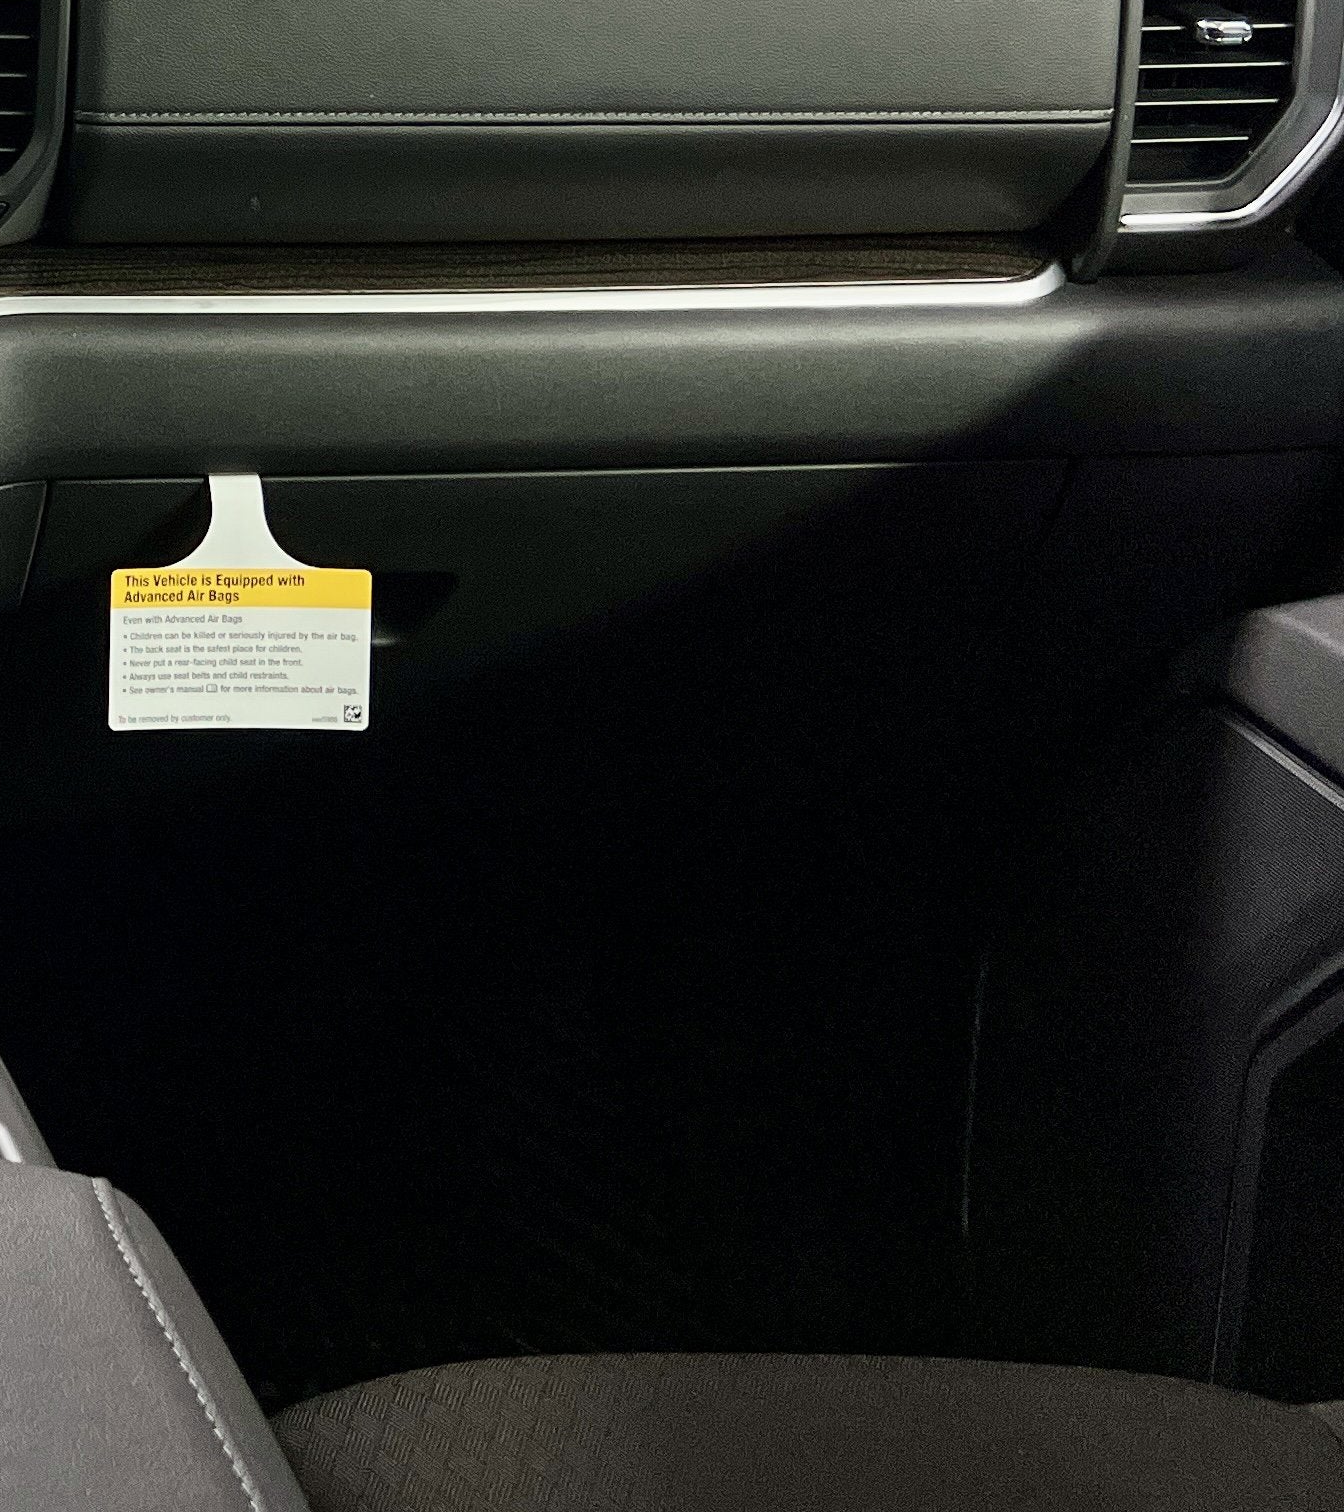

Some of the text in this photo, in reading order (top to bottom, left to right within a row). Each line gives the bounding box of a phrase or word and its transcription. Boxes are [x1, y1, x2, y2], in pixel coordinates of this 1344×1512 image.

[125, 574, 305, 588] This Vehicle is Equipped with
[124, 590, 240, 604] Advanced Air Bags
[123, 615, 243, 624] Even with Advanced Air Bags
[130, 632, 163, 640] Children
[229, 631, 265, 640] seriously
[268, 631, 296, 640] injured
[299, 632, 308, 640] by
[312, 632, 324, 640] the
[207, 645, 230, 653] safest
[232, 645, 253, 654] place
[130, 659, 151, 667] Never
[153, 660, 166, 668] put
[175, 658, 216, 667] rear-facing
[219, 658, 237, 666] child
[129, 673, 155, 681] Always
[129, 686, 143, 694] See
[176, 685, 203, 693] manual
[255, 685, 298, 693] information
